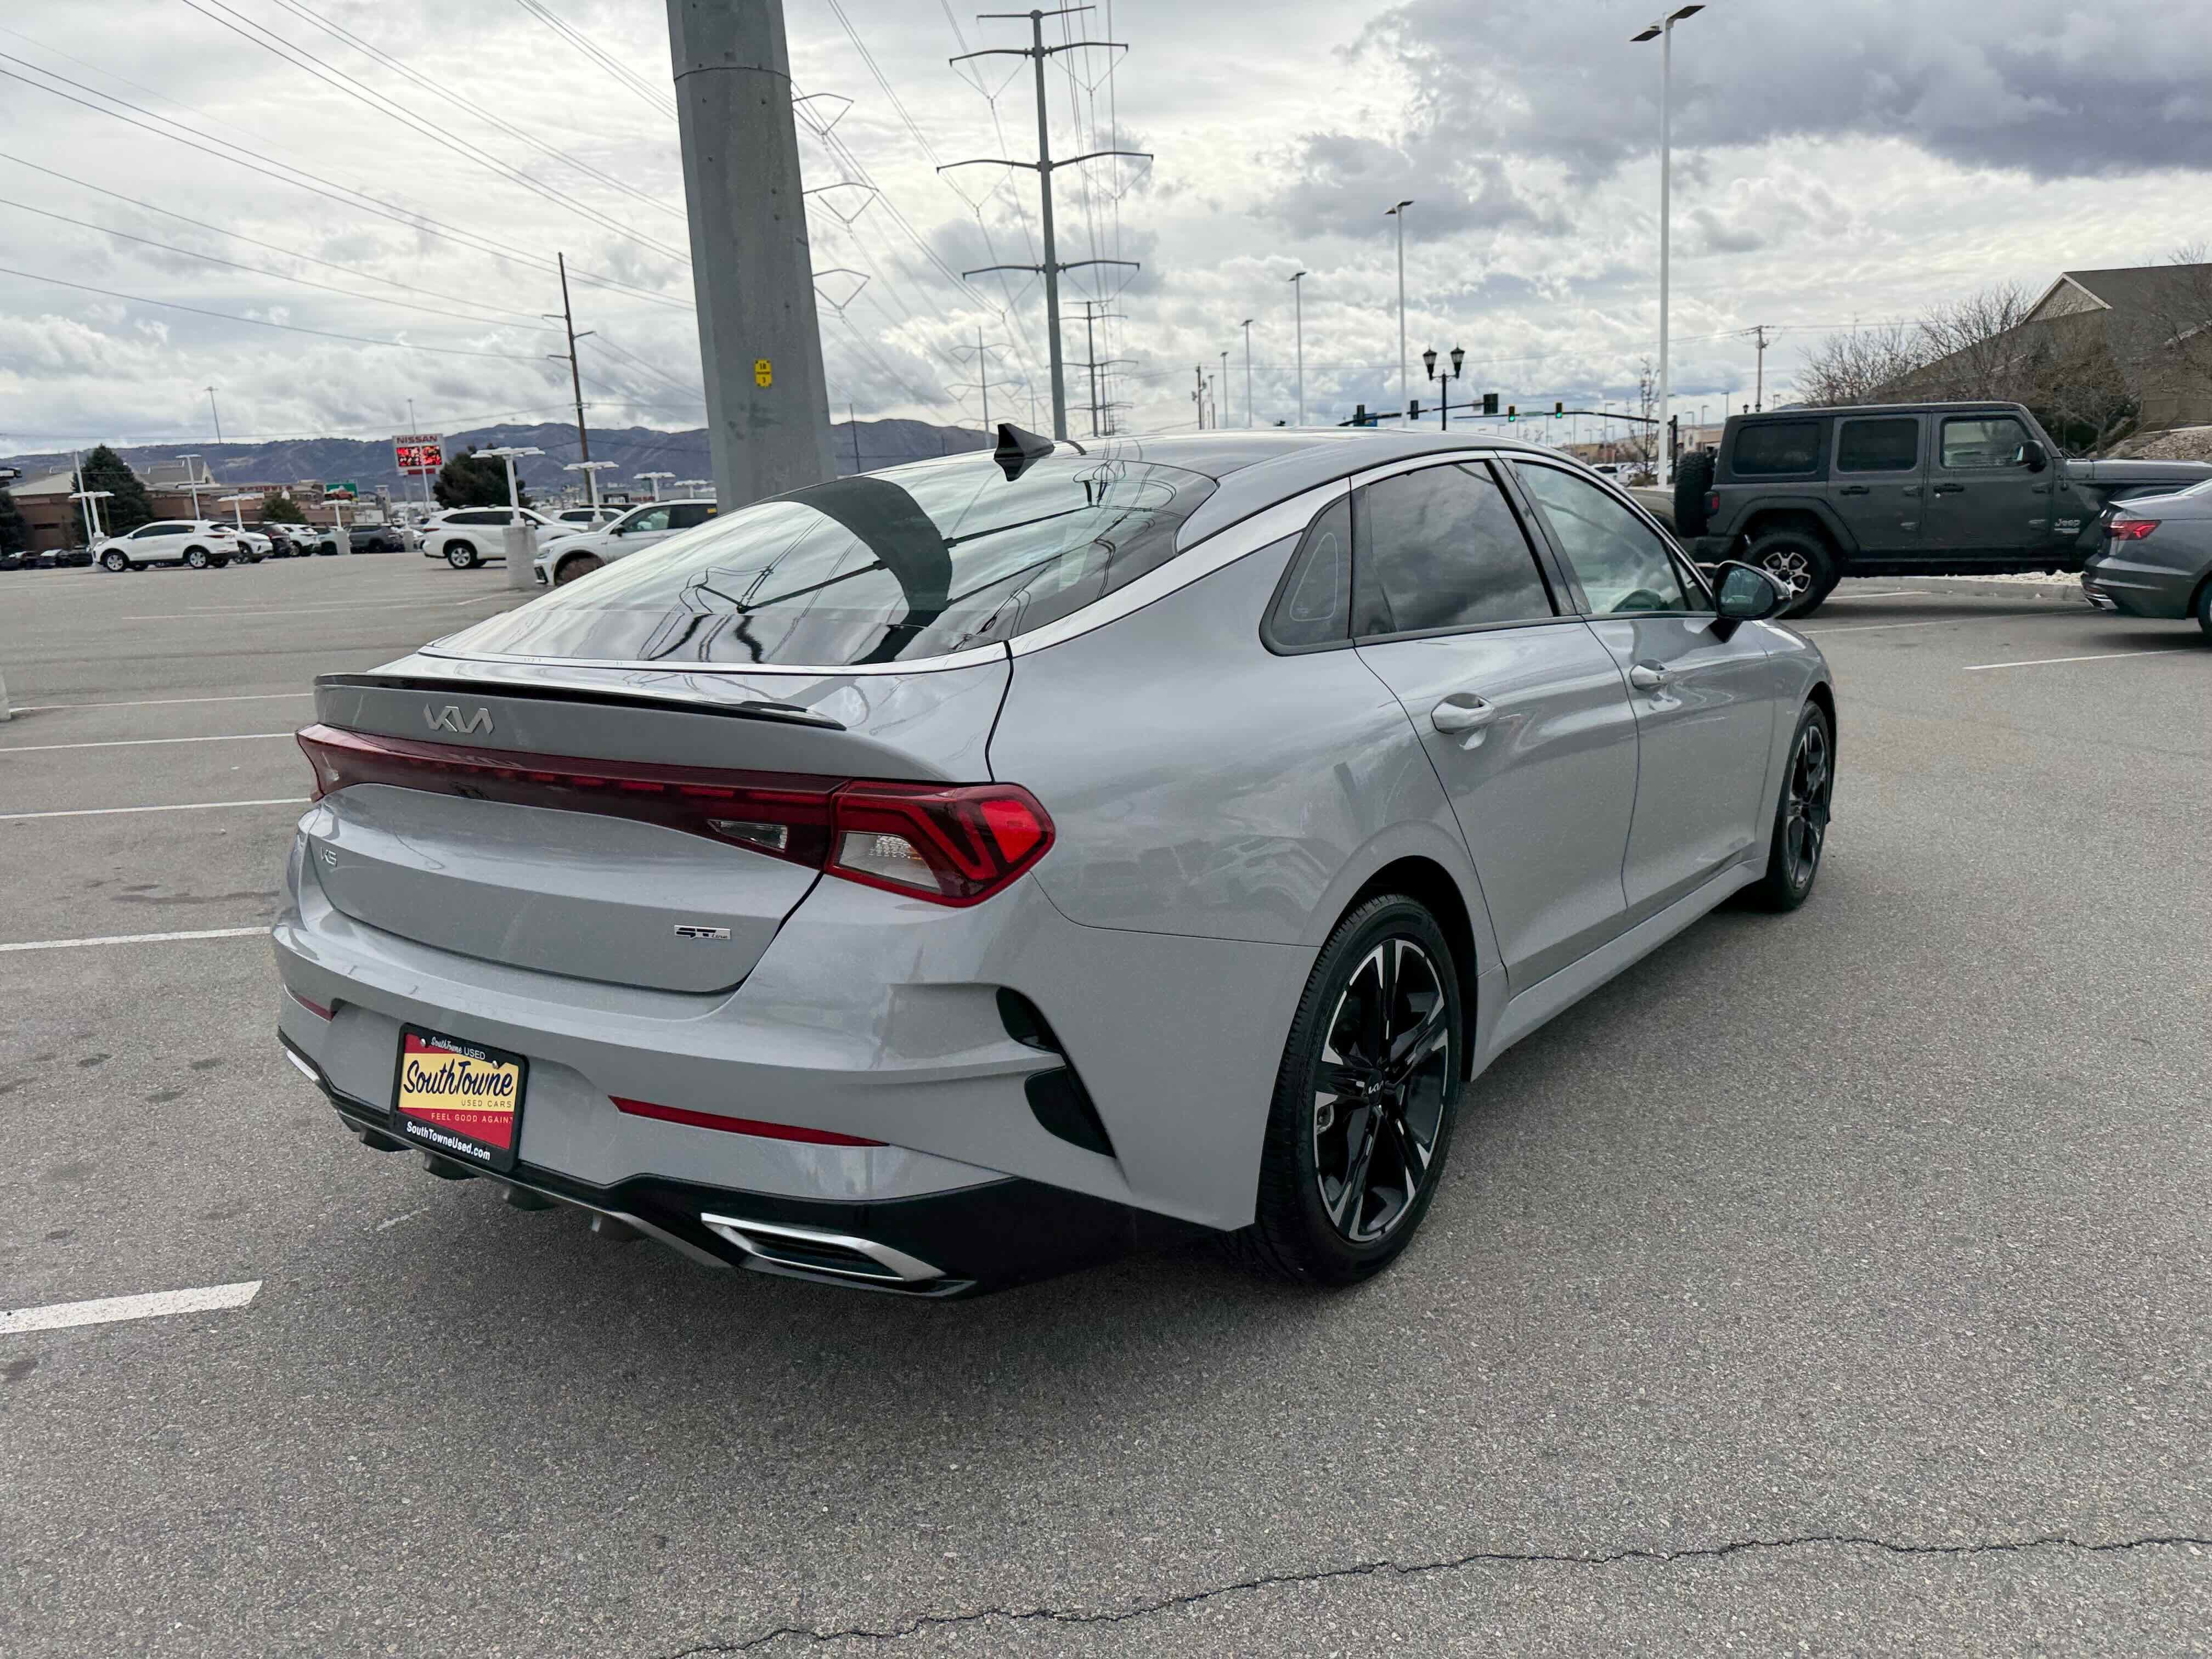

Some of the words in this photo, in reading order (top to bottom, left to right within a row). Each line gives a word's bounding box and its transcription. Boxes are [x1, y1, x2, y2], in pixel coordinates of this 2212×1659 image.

[397, 436, 437, 444] NISSAN
[2054, 518, 2080, 527] Jeep
[422, 703, 495, 734] KIA
[431, 1036, 462, 1054] SouthTowne
[464, 1047, 486, 1060] USED
[403, 1058, 514, 1097] SouthTowne
[461, 1099, 482, 1107] USED
[431, 1113, 451, 1121] FEEL
[455, 1114, 478, 1122] GOOD
[407, 1121, 490, 1161] SouthTowneUsed.com
